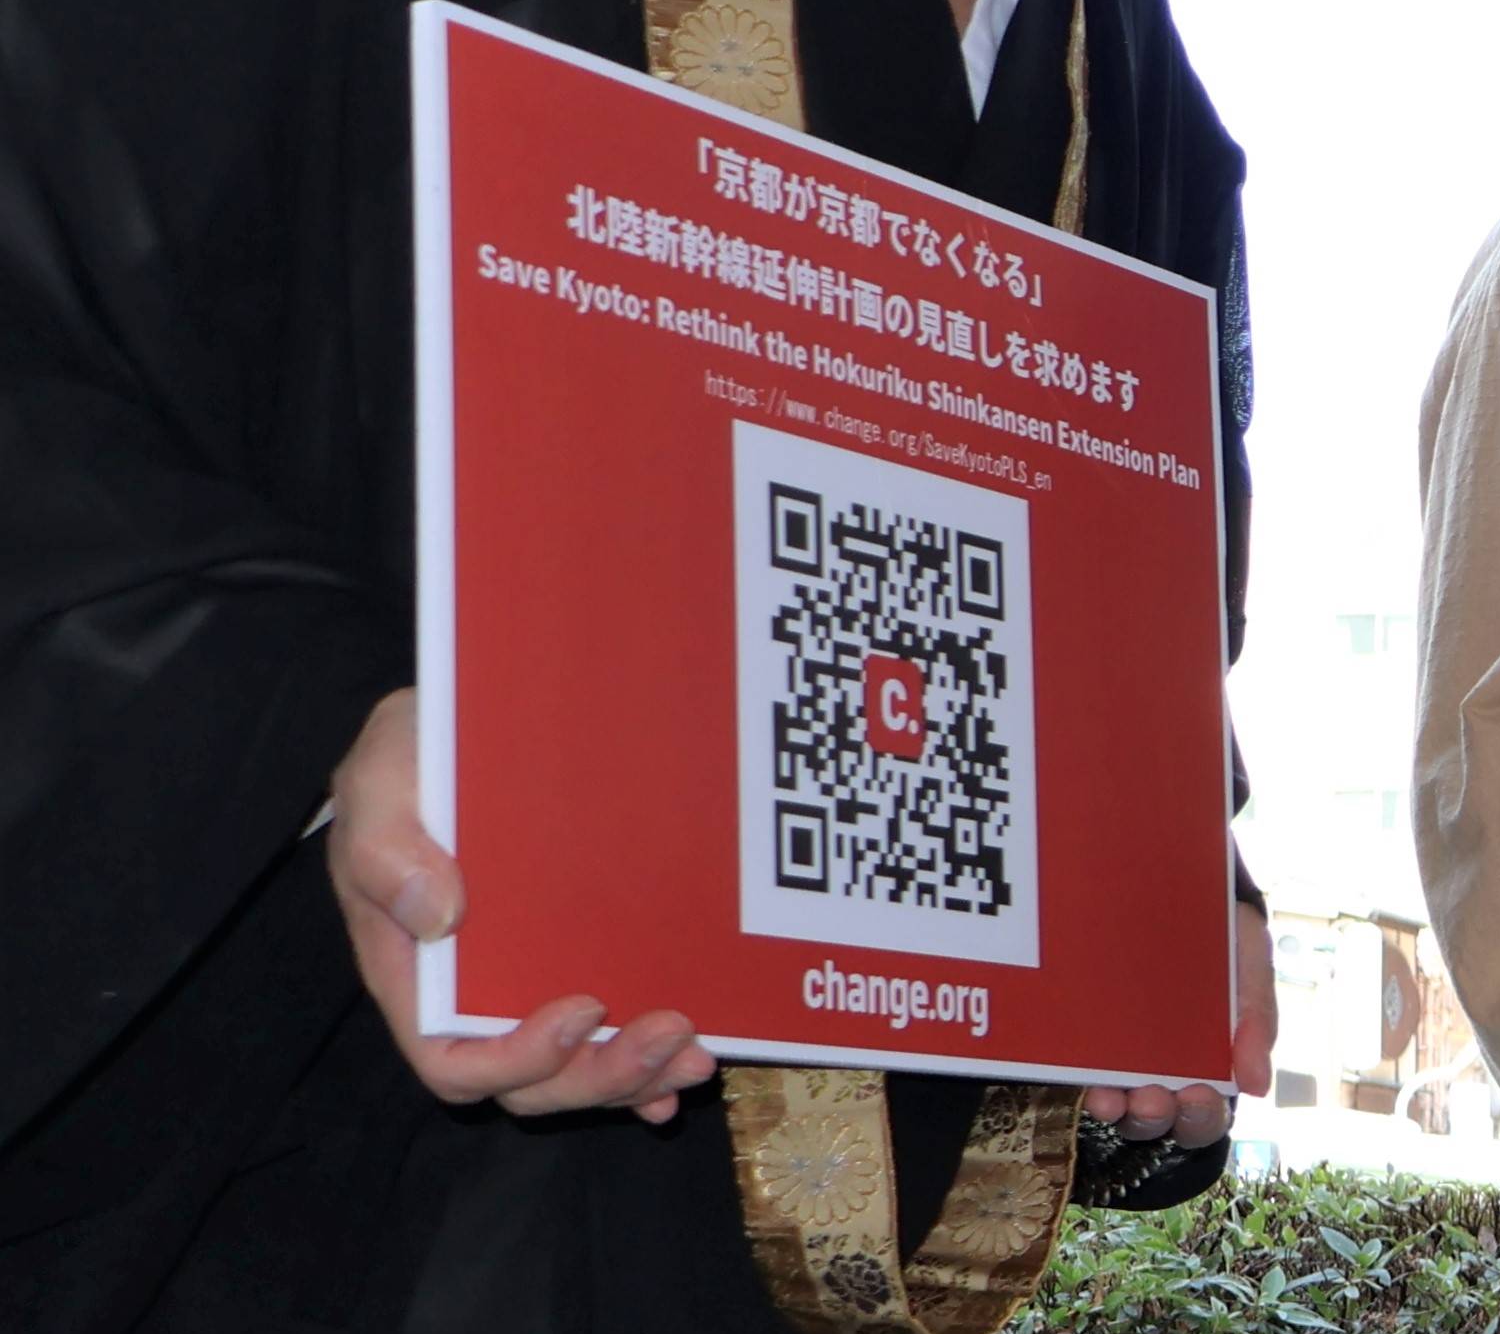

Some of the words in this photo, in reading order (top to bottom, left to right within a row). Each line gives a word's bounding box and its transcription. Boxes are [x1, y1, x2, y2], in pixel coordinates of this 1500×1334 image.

[564, 183, 1141, 412] 北陸新幹線延伸計画の見直しを求めます
[696, 136, 1043, 308] 「京都が京都でなくなる」
[477, 242, 551, 295] Save
[556, 267, 652, 325] Kyoto:
[656, 296, 762, 357] Rethink
[764, 329, 808, 371] the
[812, 344, 924, 406] Hokuriku
[926, 380, 1054, 446] Shinkansen
[1057, 420, 1155, 476] Extension
[1158, 451, 1201, 491] Plan
[802, 959, 991, 1038] change.org
